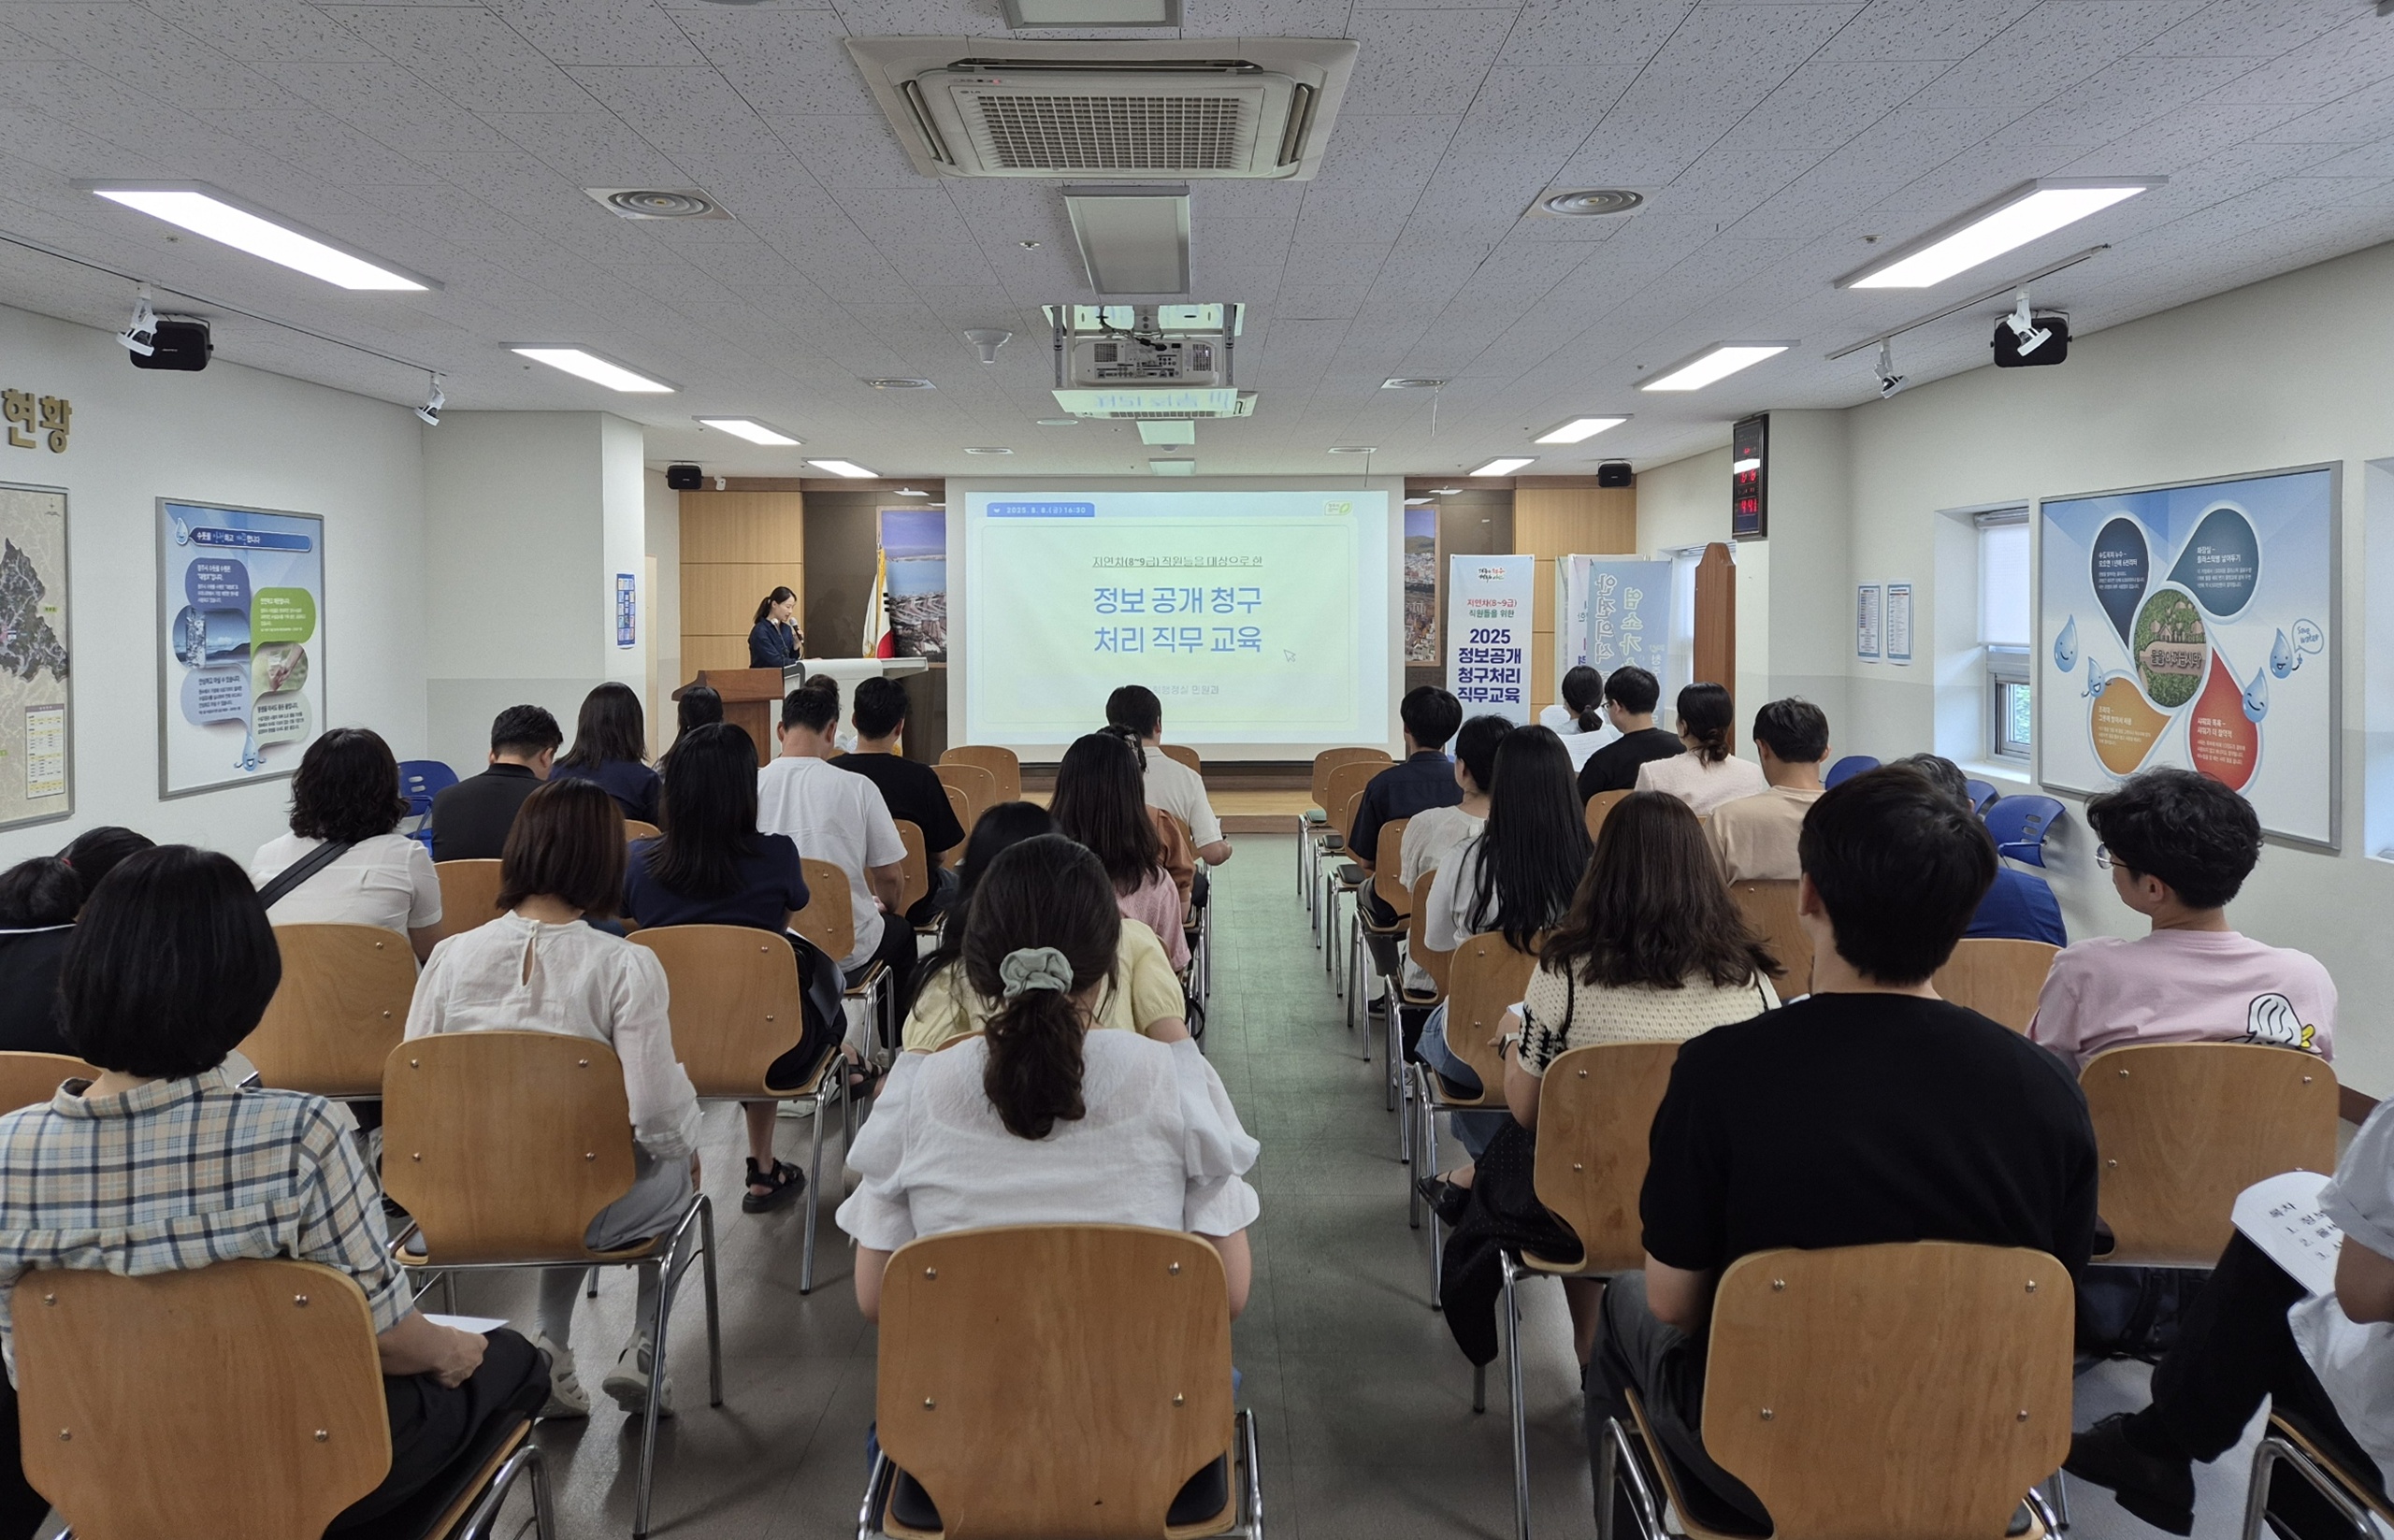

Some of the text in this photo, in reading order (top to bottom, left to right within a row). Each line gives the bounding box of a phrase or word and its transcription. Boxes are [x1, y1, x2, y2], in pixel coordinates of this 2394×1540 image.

[1, 388, 72, 453] 현황
[1093, 587, 1262, 614] 정보 공개 청구
[1500, 610, 1515, 618] 위한
[1093, 626, 1262, 655] 처리 직무 교육
[1469, 628, 1511, 644] 2025
[1458, 647, 1521, 664] 정보공개
[1458, 667, 1521, 684] 청구처리
[1149, 684, 1190, 695] 획행정실
[1457, 686, 1520, 703] 직무교육
